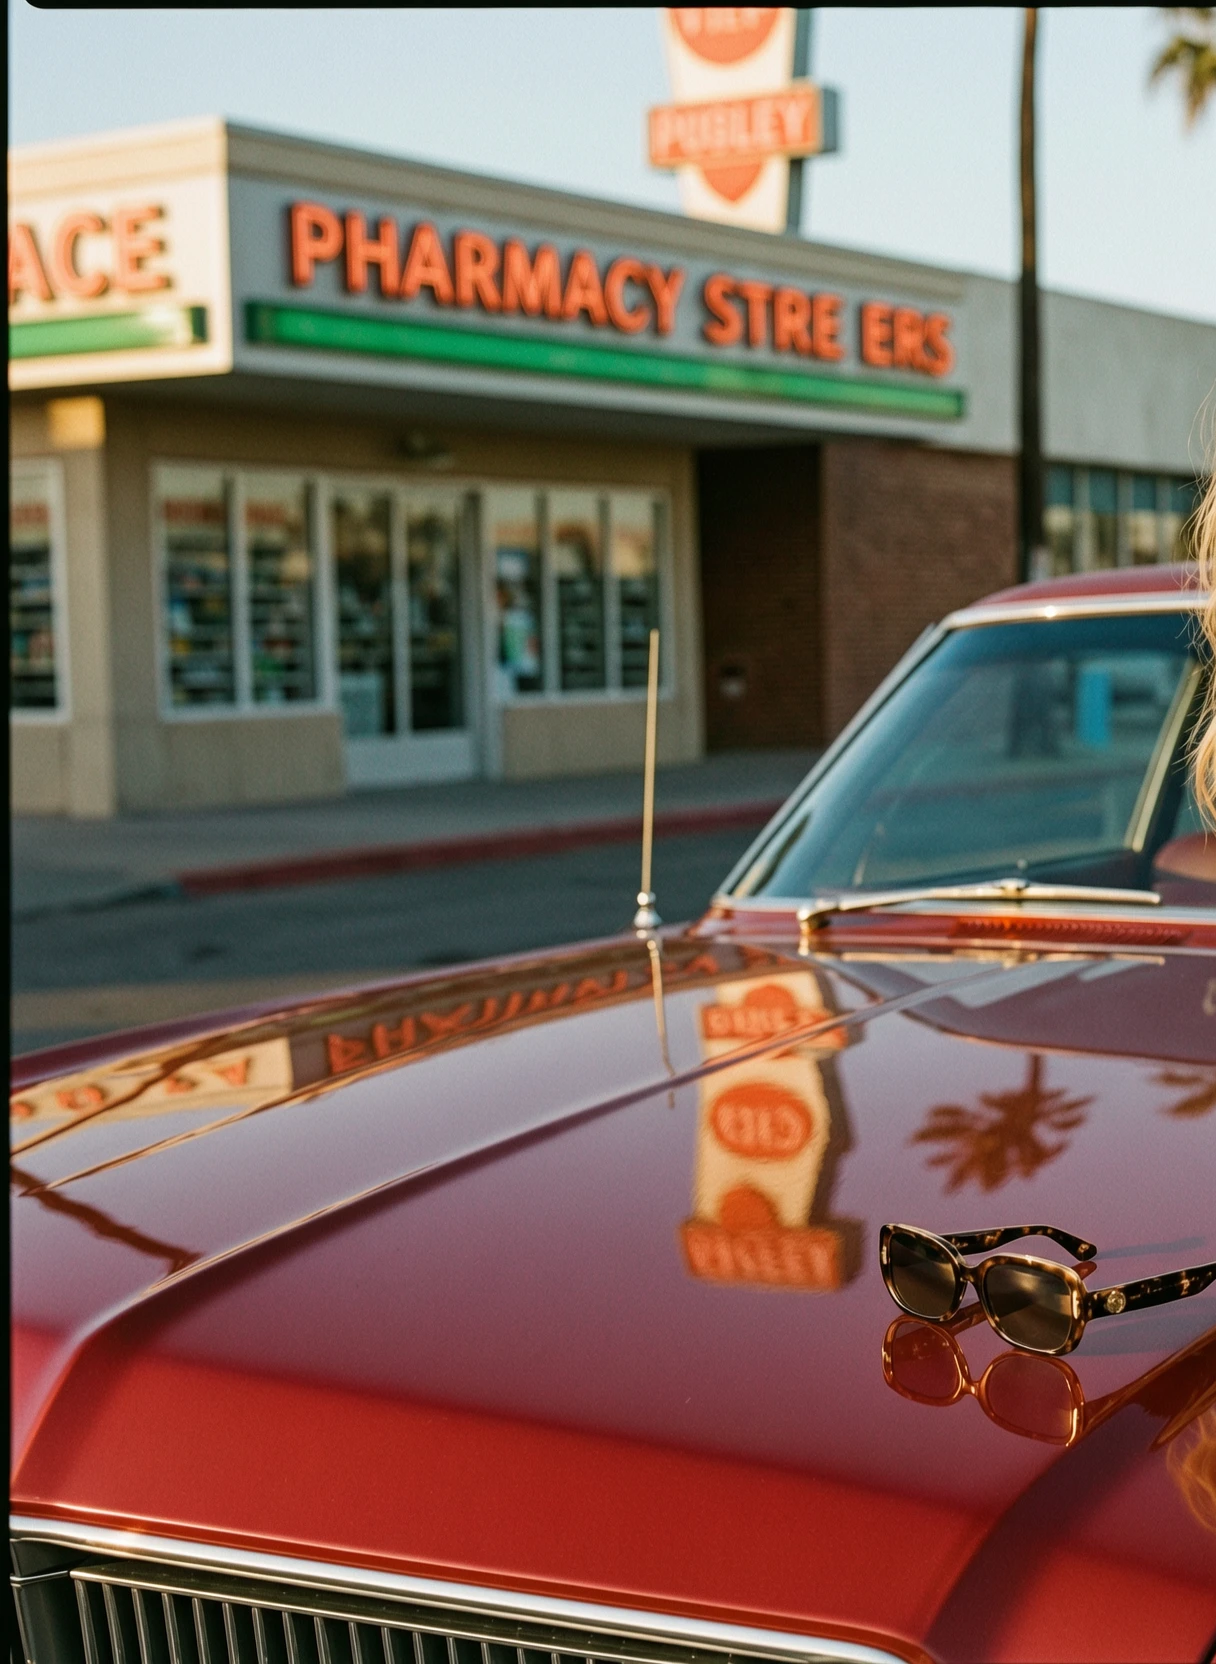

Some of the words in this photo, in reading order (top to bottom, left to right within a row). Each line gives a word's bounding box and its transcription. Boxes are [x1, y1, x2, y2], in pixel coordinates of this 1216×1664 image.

[9, 204, 170, 304] ACE
[289, 201, 685, 335] PHARMACY
[703, 272, 844, 361] STRE
[861, 301, 955, 377] ERS
